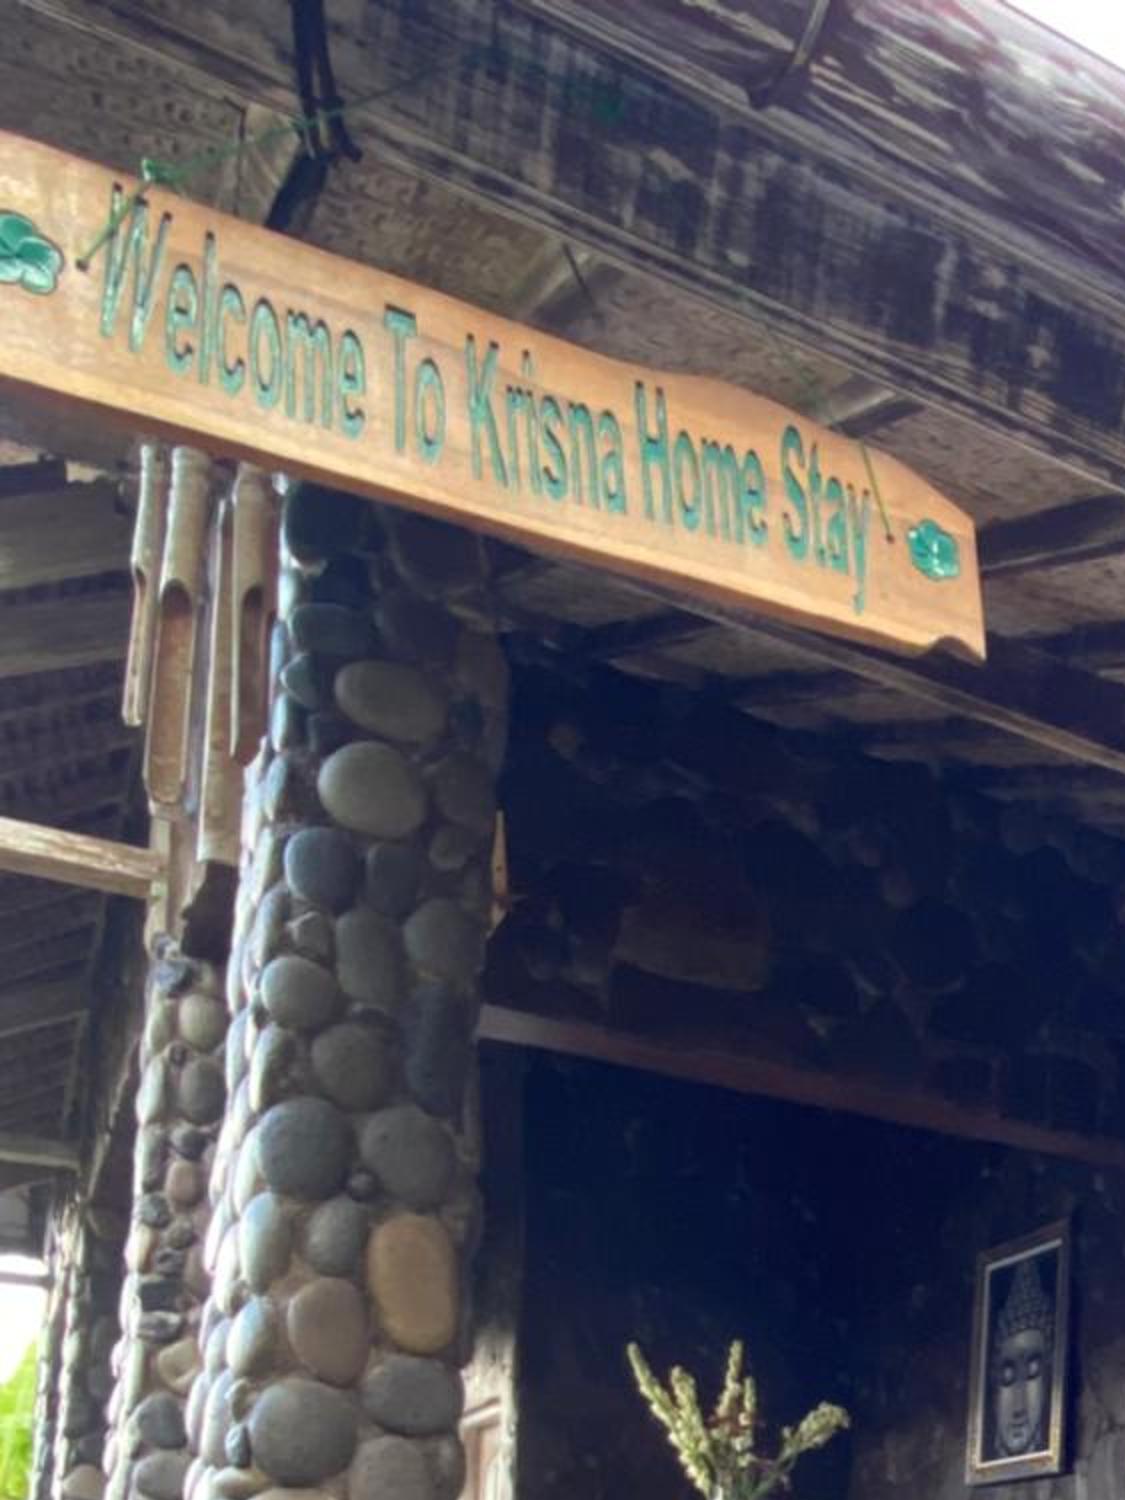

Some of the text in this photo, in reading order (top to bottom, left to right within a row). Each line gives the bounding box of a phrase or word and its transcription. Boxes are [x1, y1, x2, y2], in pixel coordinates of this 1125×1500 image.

[101, 182, 870, 614] Welcome To Krisna Home Stay
